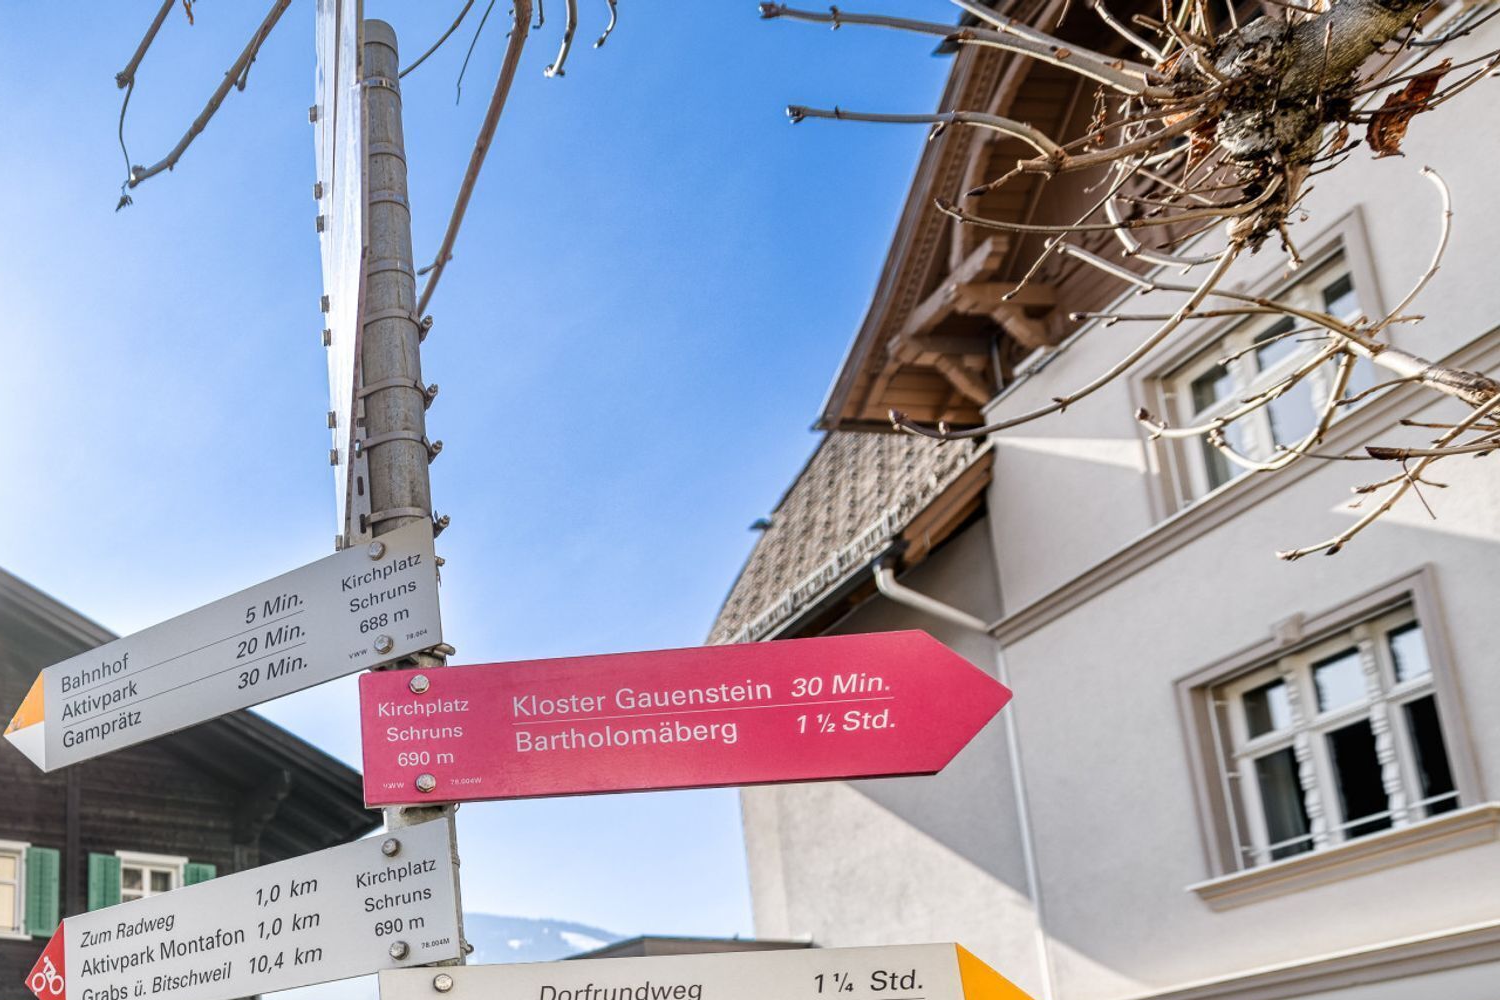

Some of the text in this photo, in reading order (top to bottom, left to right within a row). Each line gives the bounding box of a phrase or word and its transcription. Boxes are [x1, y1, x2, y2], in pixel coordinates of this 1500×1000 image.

[342, 554, 421, 591] Kirchplatz
[350, 581, 416, 612] Schruns
[360, 609, 409, 633] 688 m
[62, 594, 302, 693] Bahnhof 5 Min.
[62, 625, 305, 721] Aktivpark 20 Min.
[63, 657, 307, 747] Gamprätz 30 Min.
[379, 699, 468, 717] Kirchplatz
[514, 673, 889, 716] Kloster Gauenstein 30 Min.
[387, 726, 463, 741] Schruns
[516, 721, 737, 752] Bartholomäberg
[798, 715, 806, 733] 1
[843, 709, 894, 731] Std.
[398, 751, 453, 766] 690 m
[357, 860, 436, 888] Kirchplatz
[81, 880, 317, 948] Zum Radweg 1,0 km
[365, 889, 431, 912] Schruns
[375, 917, 424, 936] 690 m
[81, 914, 319, 977] Aktivpark Montafon 1,0 km
[135, 980, 146, 997] ü.
[153, 962, 231, 993] Bitschweil
[250, 952, 283, 973] 10,4
[295, 948, 322, 965] km
[815, 974, 823, 993] 1
[871, 969, 922, 991] Std.
